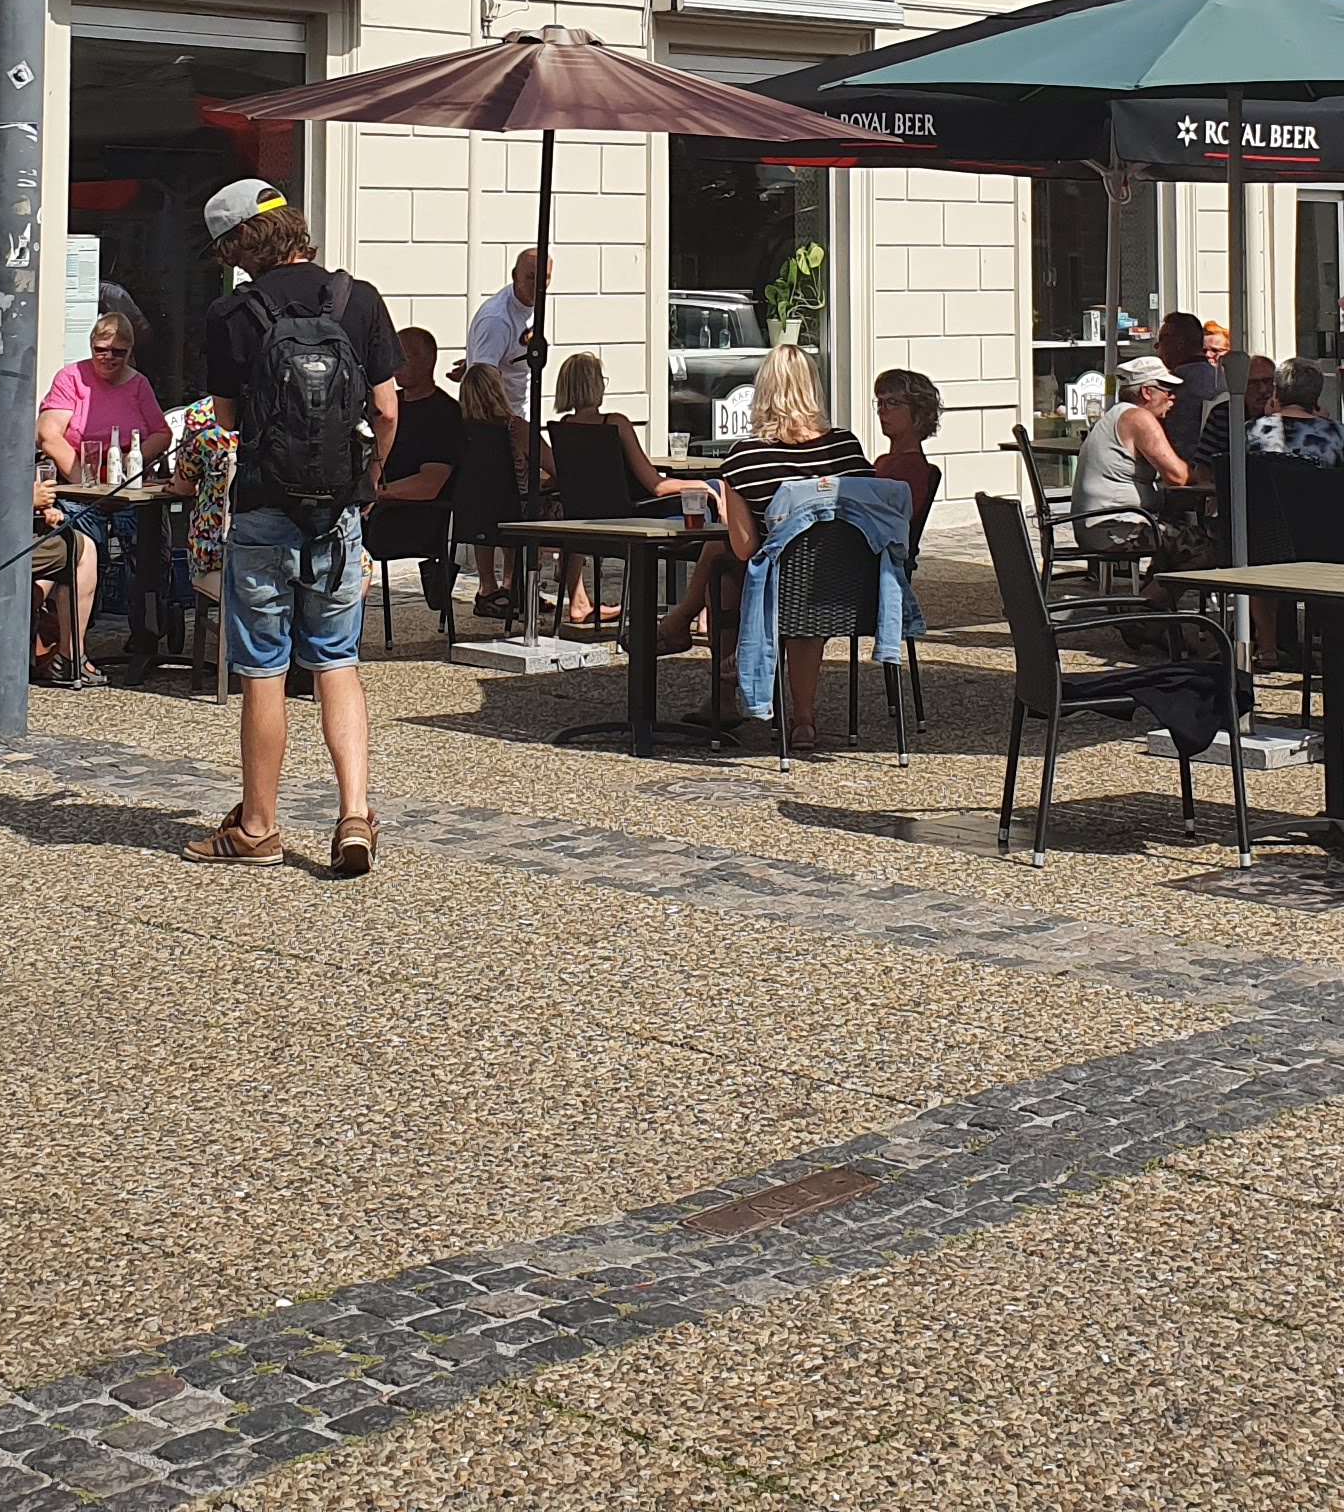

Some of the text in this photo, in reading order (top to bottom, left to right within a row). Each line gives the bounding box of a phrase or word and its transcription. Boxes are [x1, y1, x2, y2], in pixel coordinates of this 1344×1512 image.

[894, 113, 937, 136] BEER
[1205, 120, 1320, 150] ROAL BEER
